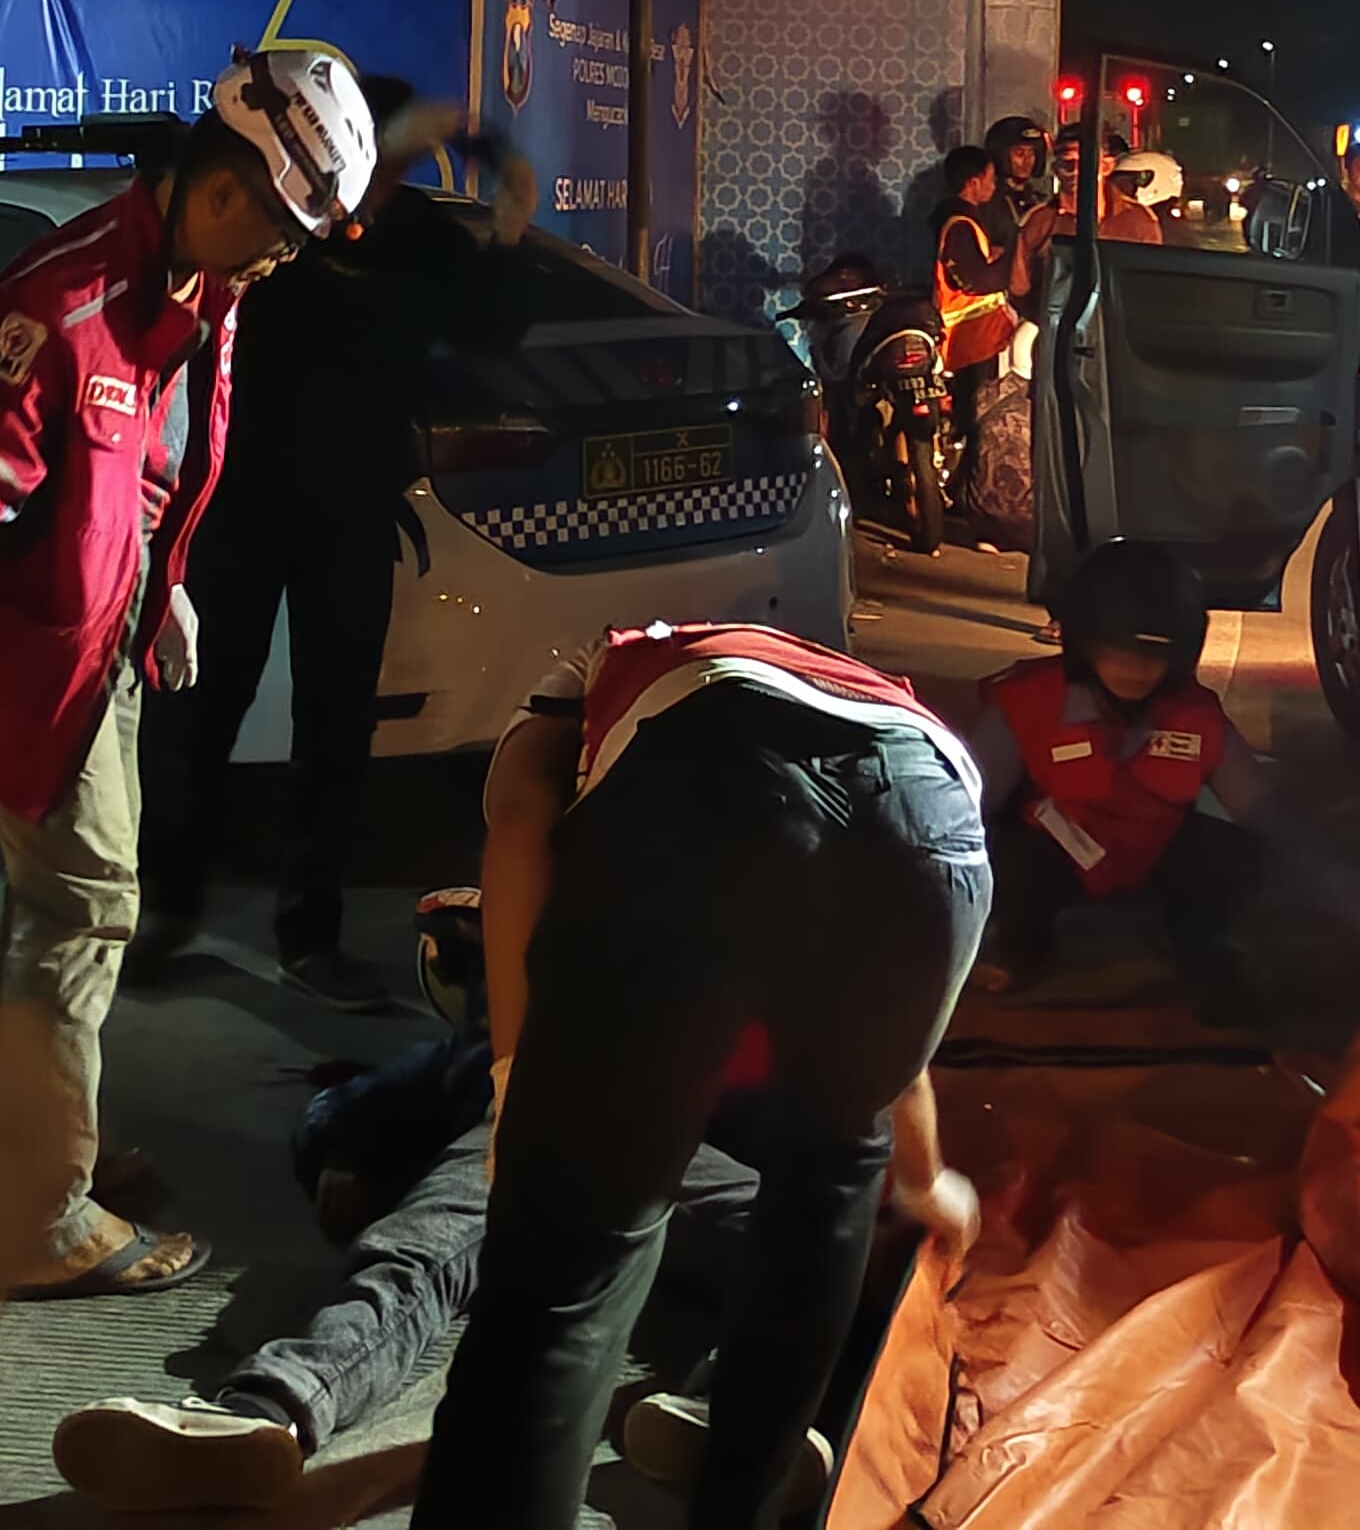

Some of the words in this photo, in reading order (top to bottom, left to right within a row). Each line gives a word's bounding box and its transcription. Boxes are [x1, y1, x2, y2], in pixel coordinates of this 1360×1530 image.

[101, 79, 176, 114] Hari
[554, 176, 606, 212] SELAMAT
[607, 178, 628, 210] HAR
[643, 451, 722, 486] 1166-62
